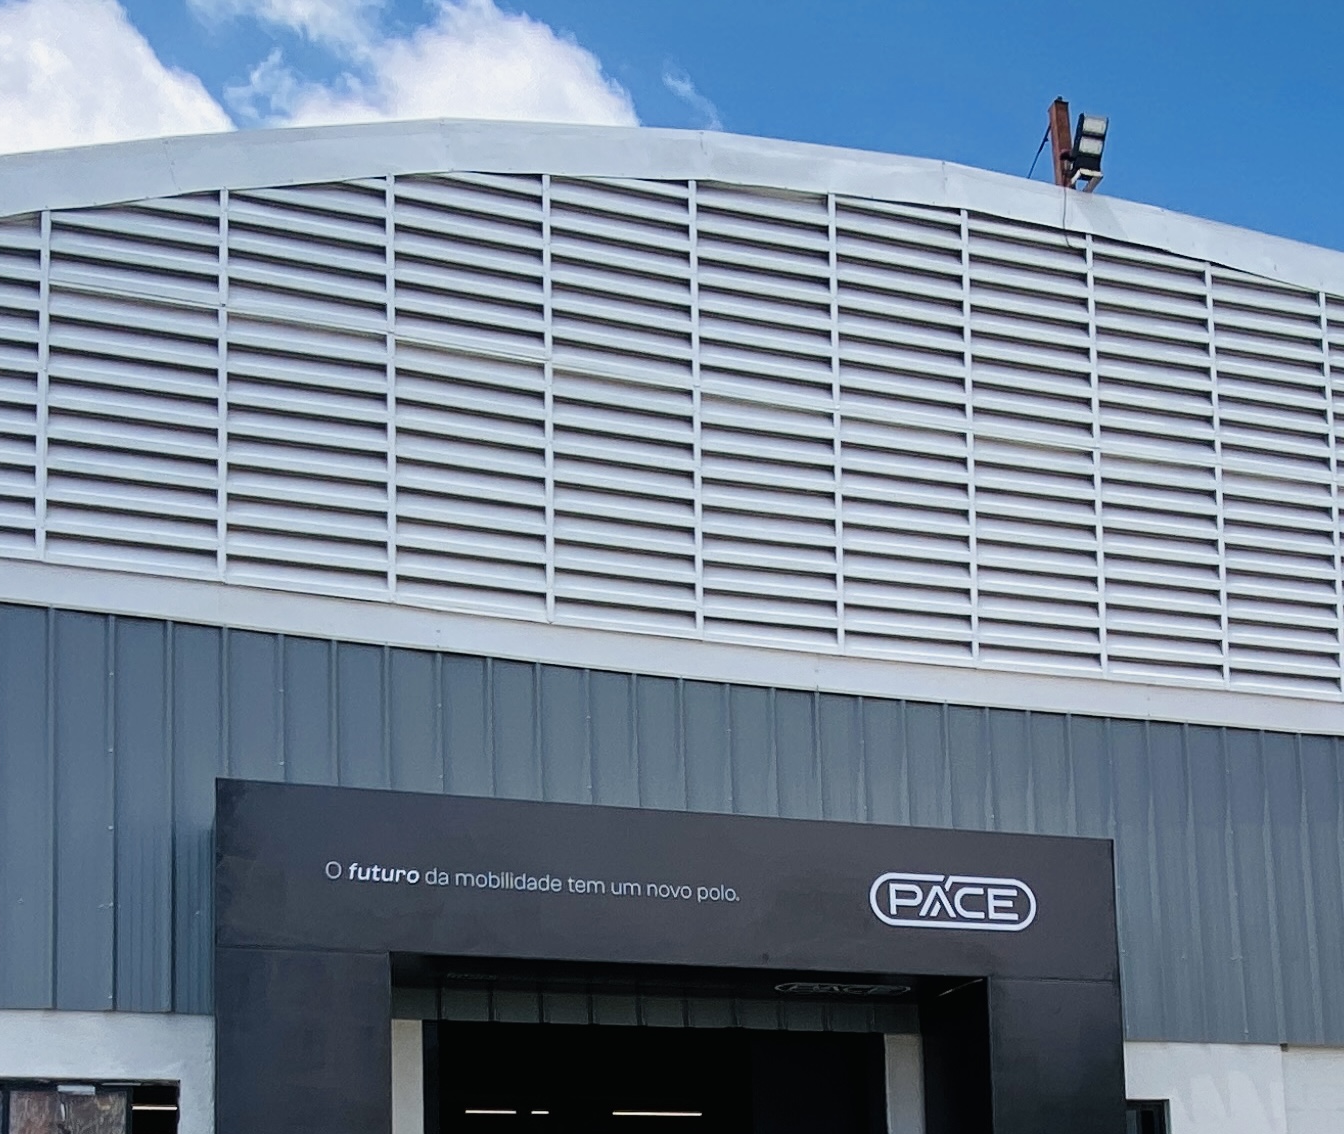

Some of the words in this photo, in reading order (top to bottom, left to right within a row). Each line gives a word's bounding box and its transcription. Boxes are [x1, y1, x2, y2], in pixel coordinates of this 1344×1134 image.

[324, 860, 342, 880] O
[348, 862, 421, 884] futuro
[424, 867, 449, 886] da
[454, 871, 563, 893] mobilidade
[567, 876, 606, 894] tem
[610, 881, 642, 897] um
[646, 883, 693, 900] novo
[696, 884, 741, 903] polo.
[888, 882, 1019, 921] PACE
